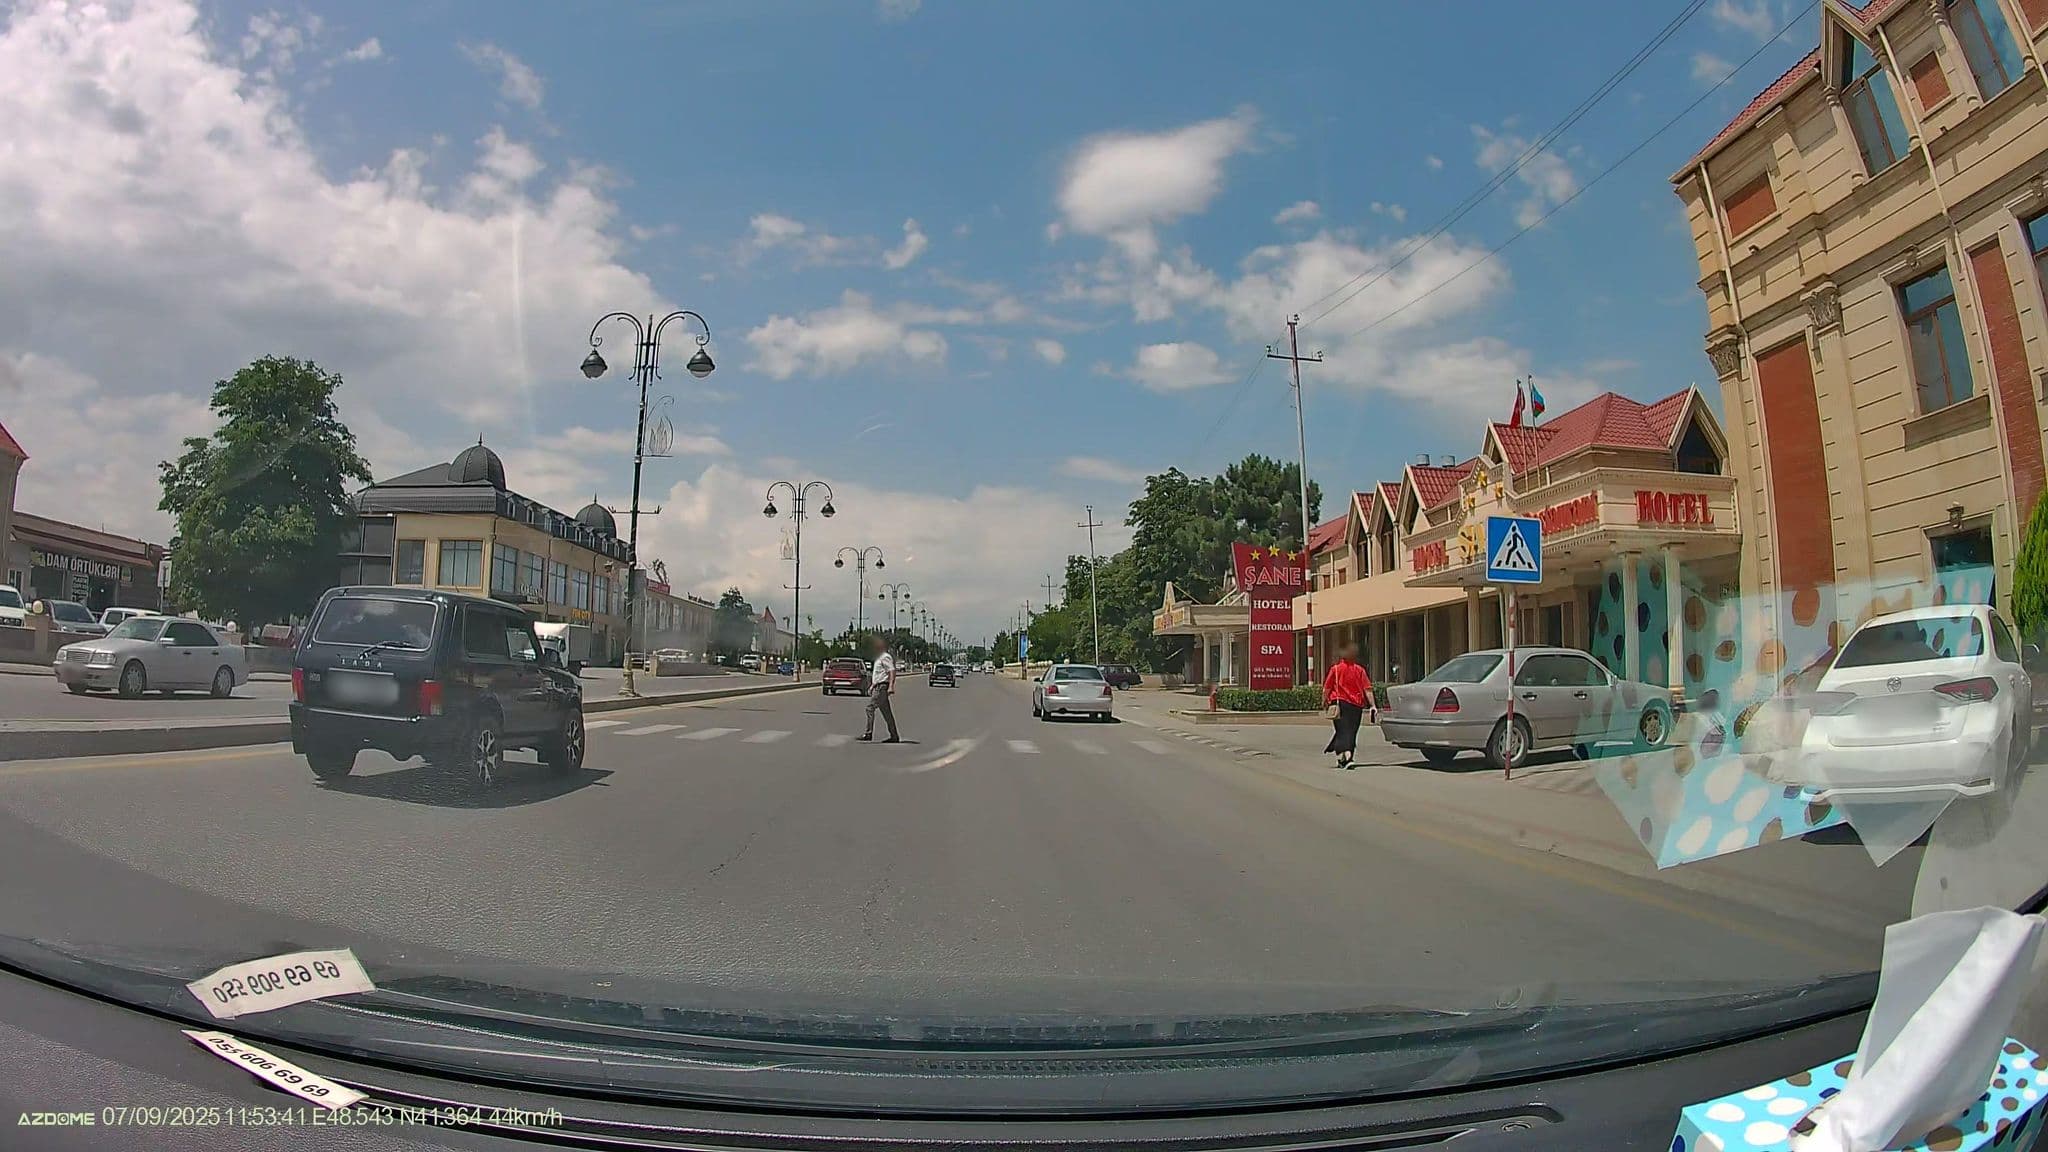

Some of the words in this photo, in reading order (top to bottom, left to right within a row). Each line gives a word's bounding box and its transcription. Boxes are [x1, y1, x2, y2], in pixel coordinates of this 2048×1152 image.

[1635, 490, 1715, 525] HOTEL
[46, 553, 68, 569] DAM
[1245, 566, 1301, 591] ŞANE
[1253, 600, 1291, 609] HOTEL
[1251, 623, 1293, 631] RESTORAN
[1261, 645, 1283, 655] SPA
[240, 1052, 276, 1070] 606
[274, 1069, 303, 1084] 69
[301, 1084, 330, 1097] 69
